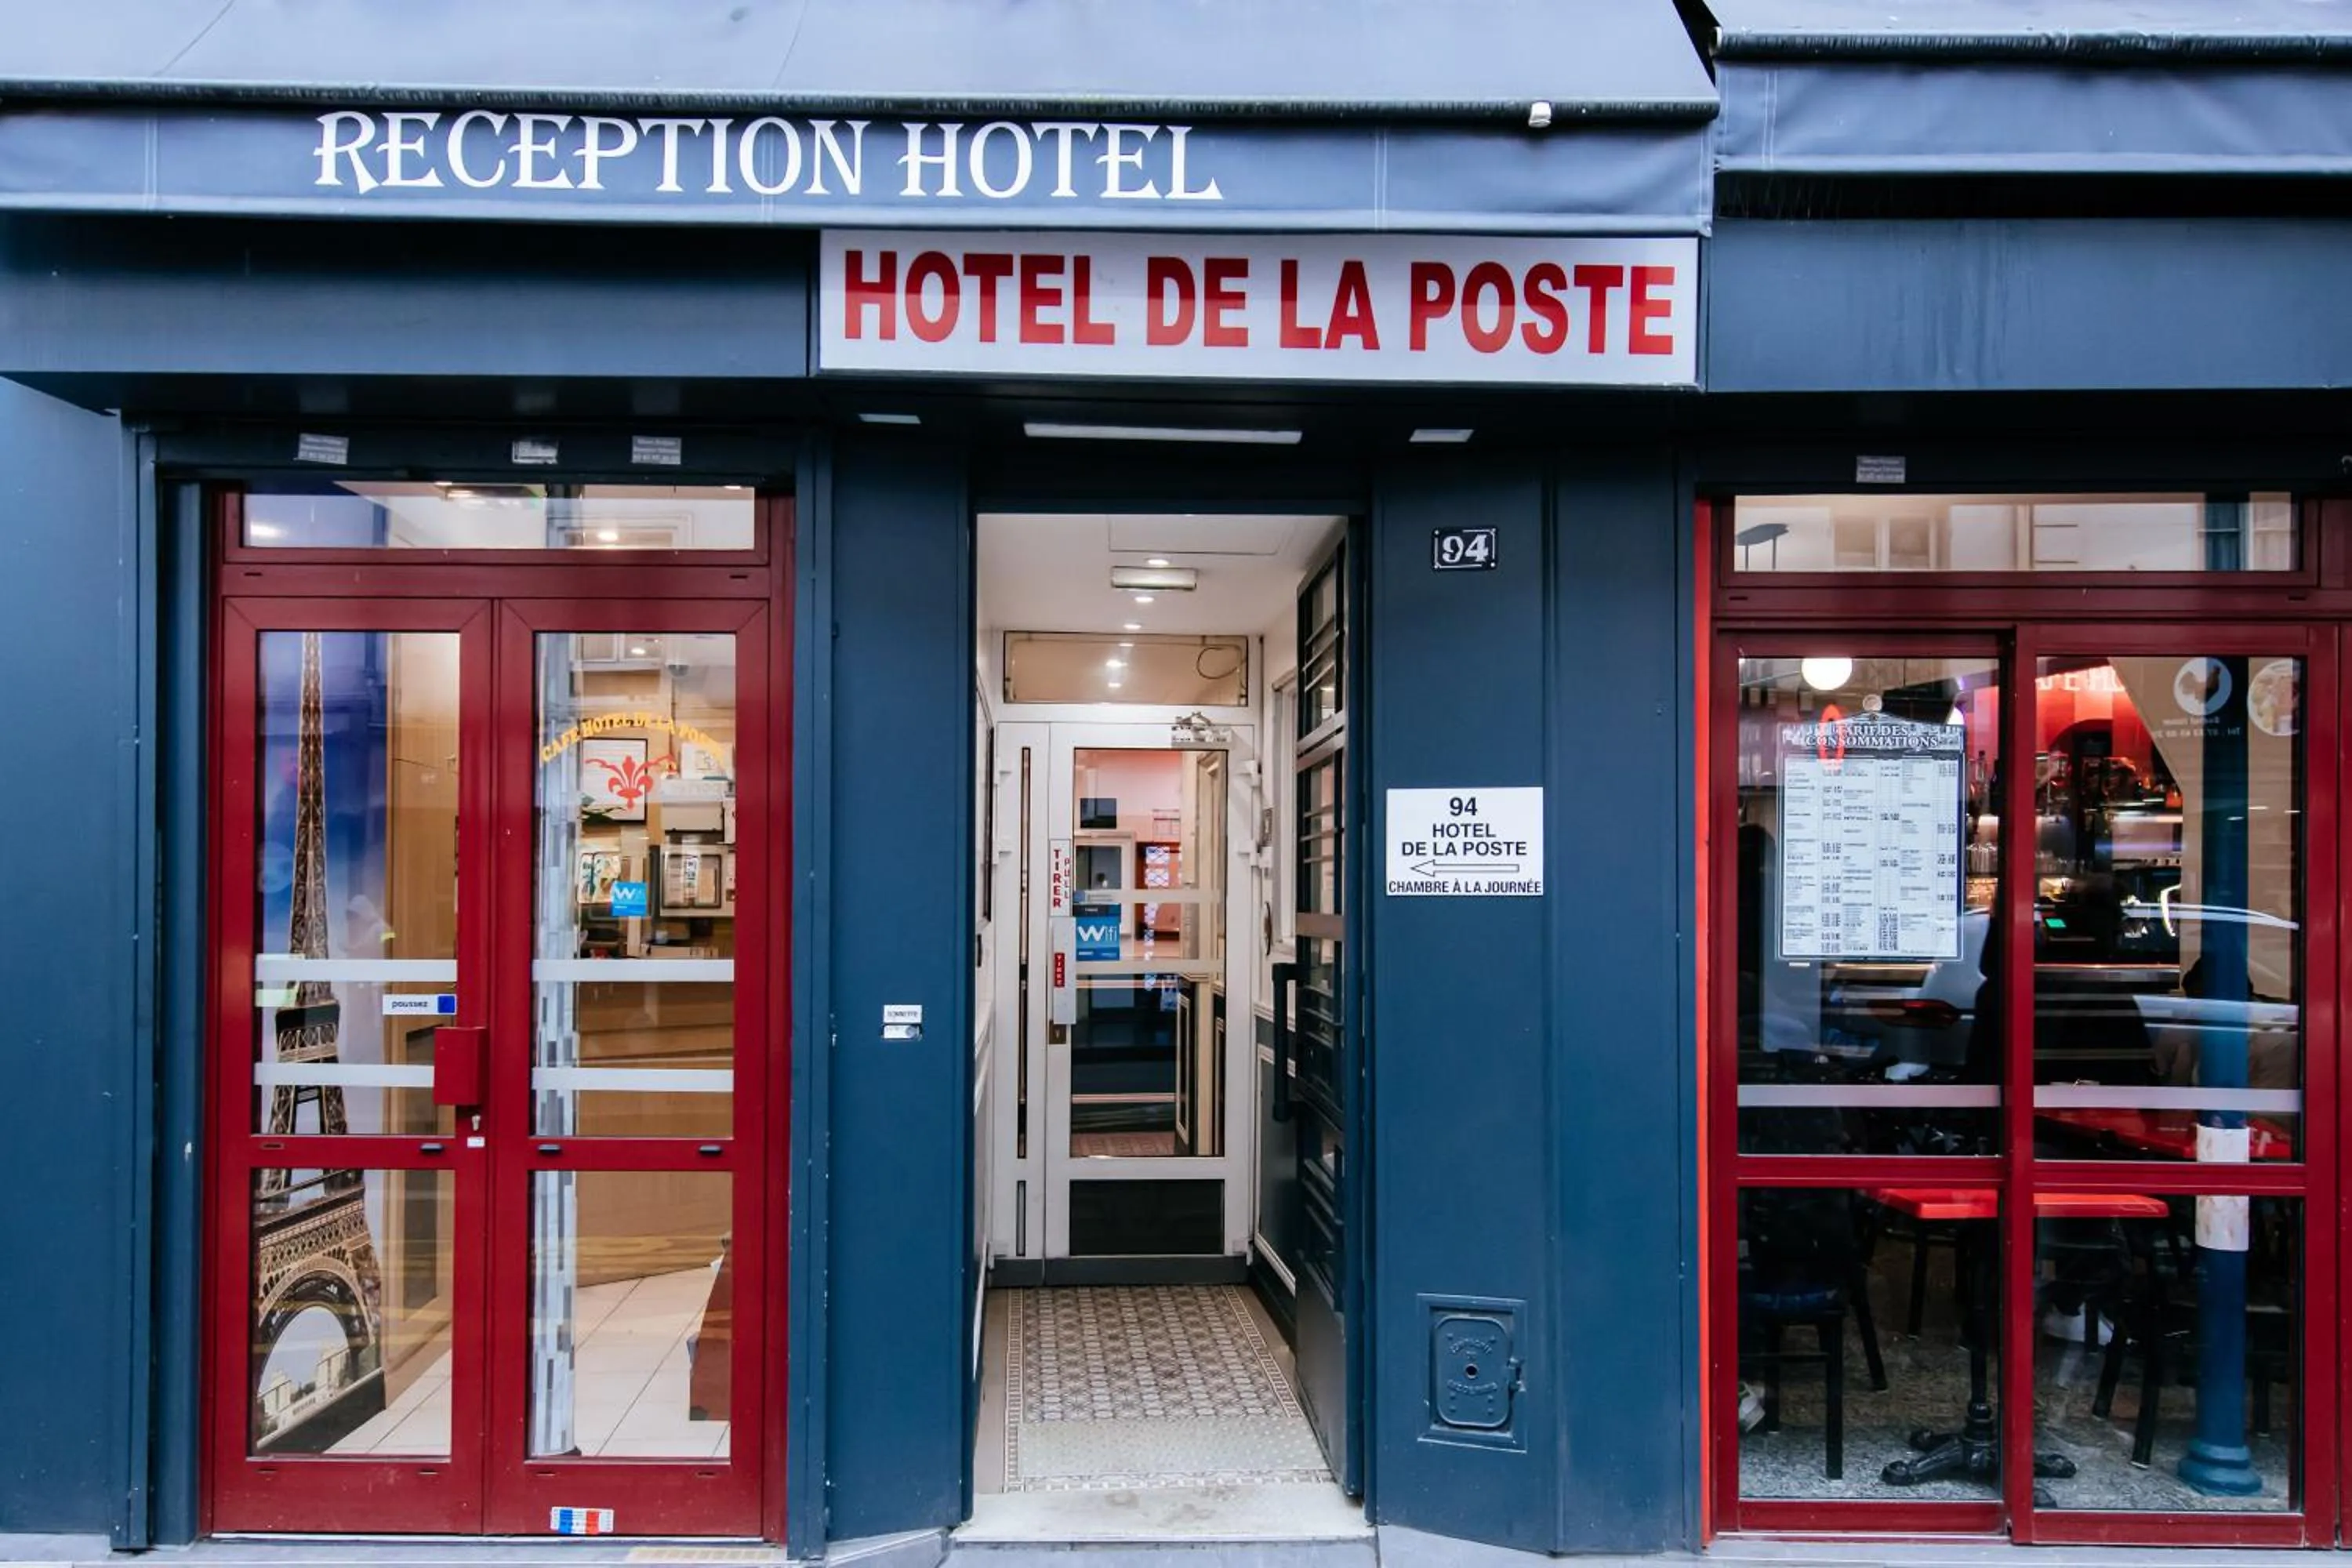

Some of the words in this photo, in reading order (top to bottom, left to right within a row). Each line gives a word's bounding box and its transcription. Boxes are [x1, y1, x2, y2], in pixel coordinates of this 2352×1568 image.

[313, 110, 872, 195] RECEPTION
[897, 121, 1224, 200] HOTEL
[844, 250, 1116, 346] HOTEL
[1146, 256, 1250, 347] DE
[1279, 260, 1381, 350] LA
[1409, 261, 1676, 355] POSTE
[1442, 534, 1489, 563] 94
[1881, 725, 1908, 737] DES
[1806, 735, 1938, 746] CONSOMMATIONS
[1449, 797, 1478, 817] 94
[1432, 823, 1496, 838] HOTEL
[1402, 842, 1427, 855] DE
[1433, 842, 1457, 855] LA
[1463, 841, 1527, 856] POSTE
[1053, 849, 1062, 908] TIRER
[1388, 880, 1449, 893] CHAMBRE
[1453, 878, 1461, 893] À
[1465, 881, 1482, 893] LA
[1484, 878, 1541, 893] JOURNÉE
[1077, 924, 1118, 942] Wifi
